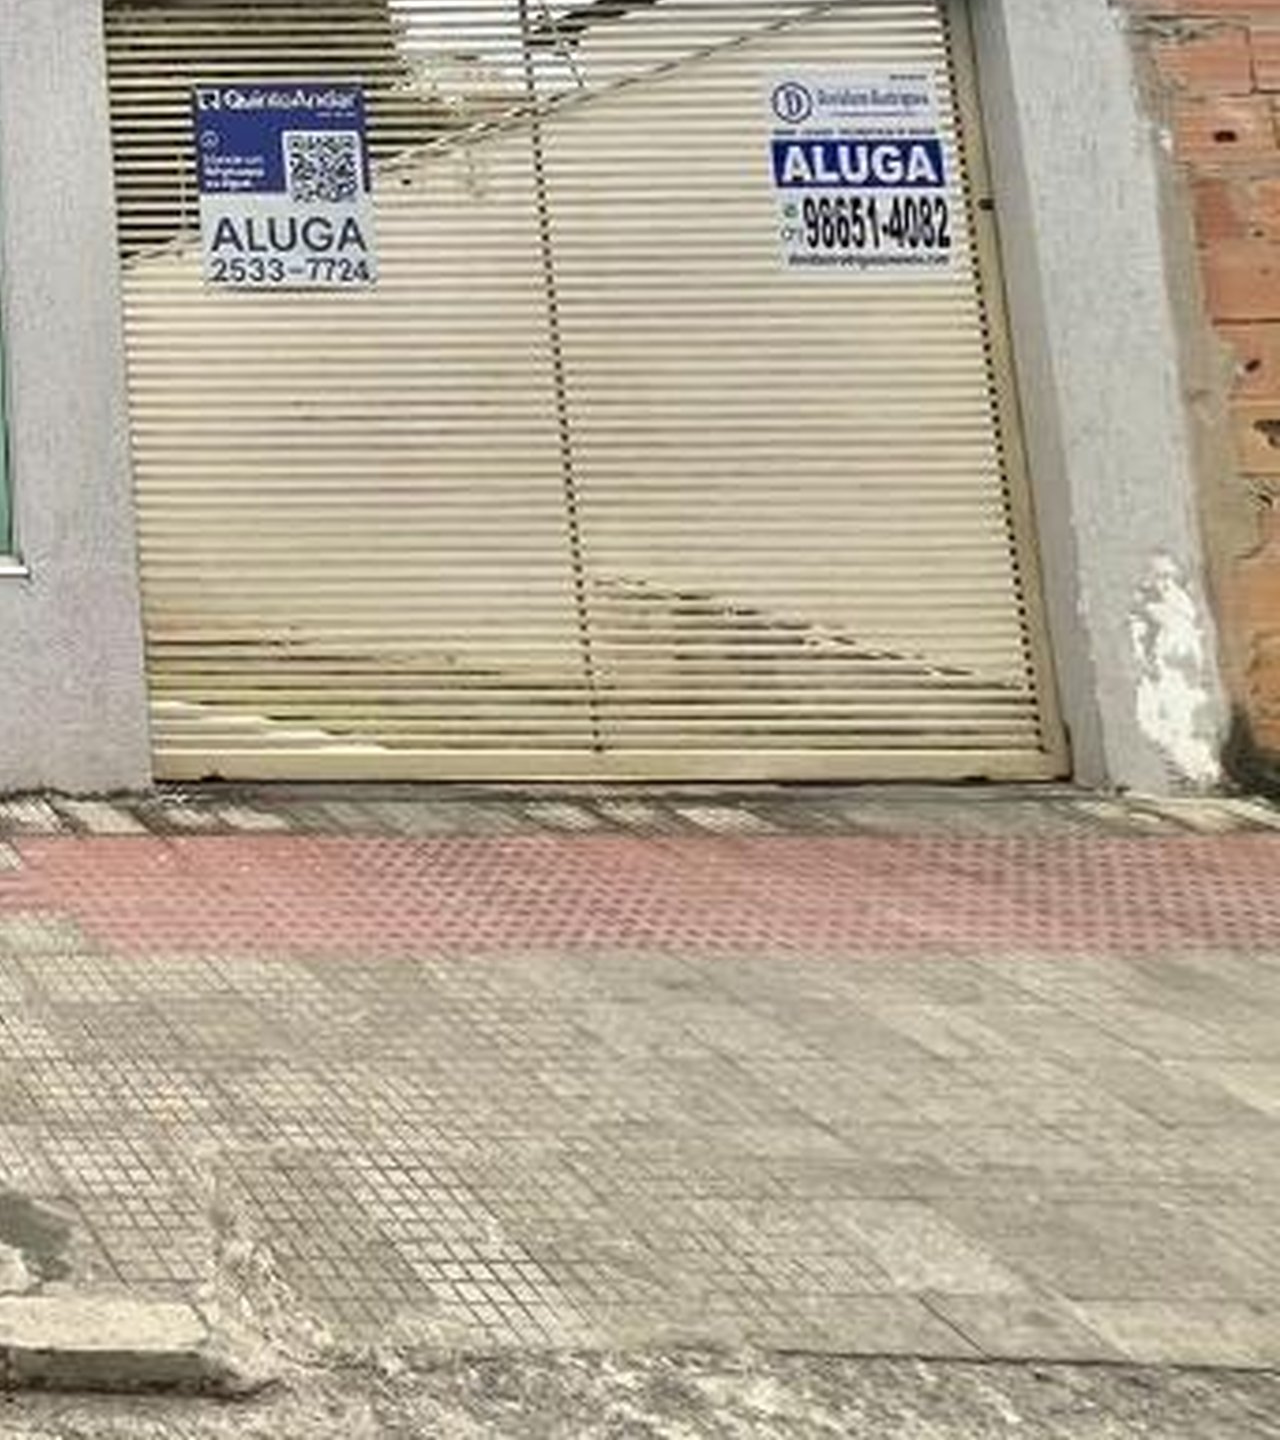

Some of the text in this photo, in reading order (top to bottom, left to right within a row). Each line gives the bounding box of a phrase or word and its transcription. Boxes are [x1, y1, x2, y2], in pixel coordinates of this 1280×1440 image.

[222, 88, 357, 110] QuintoAndar
[781, 145, 939, 184] ALUGA
[210, 216, 369, 253] ALUGA
[802, 195, 952, 249] 98651-4082
[210, 257, 370, 282] 2533-7724
